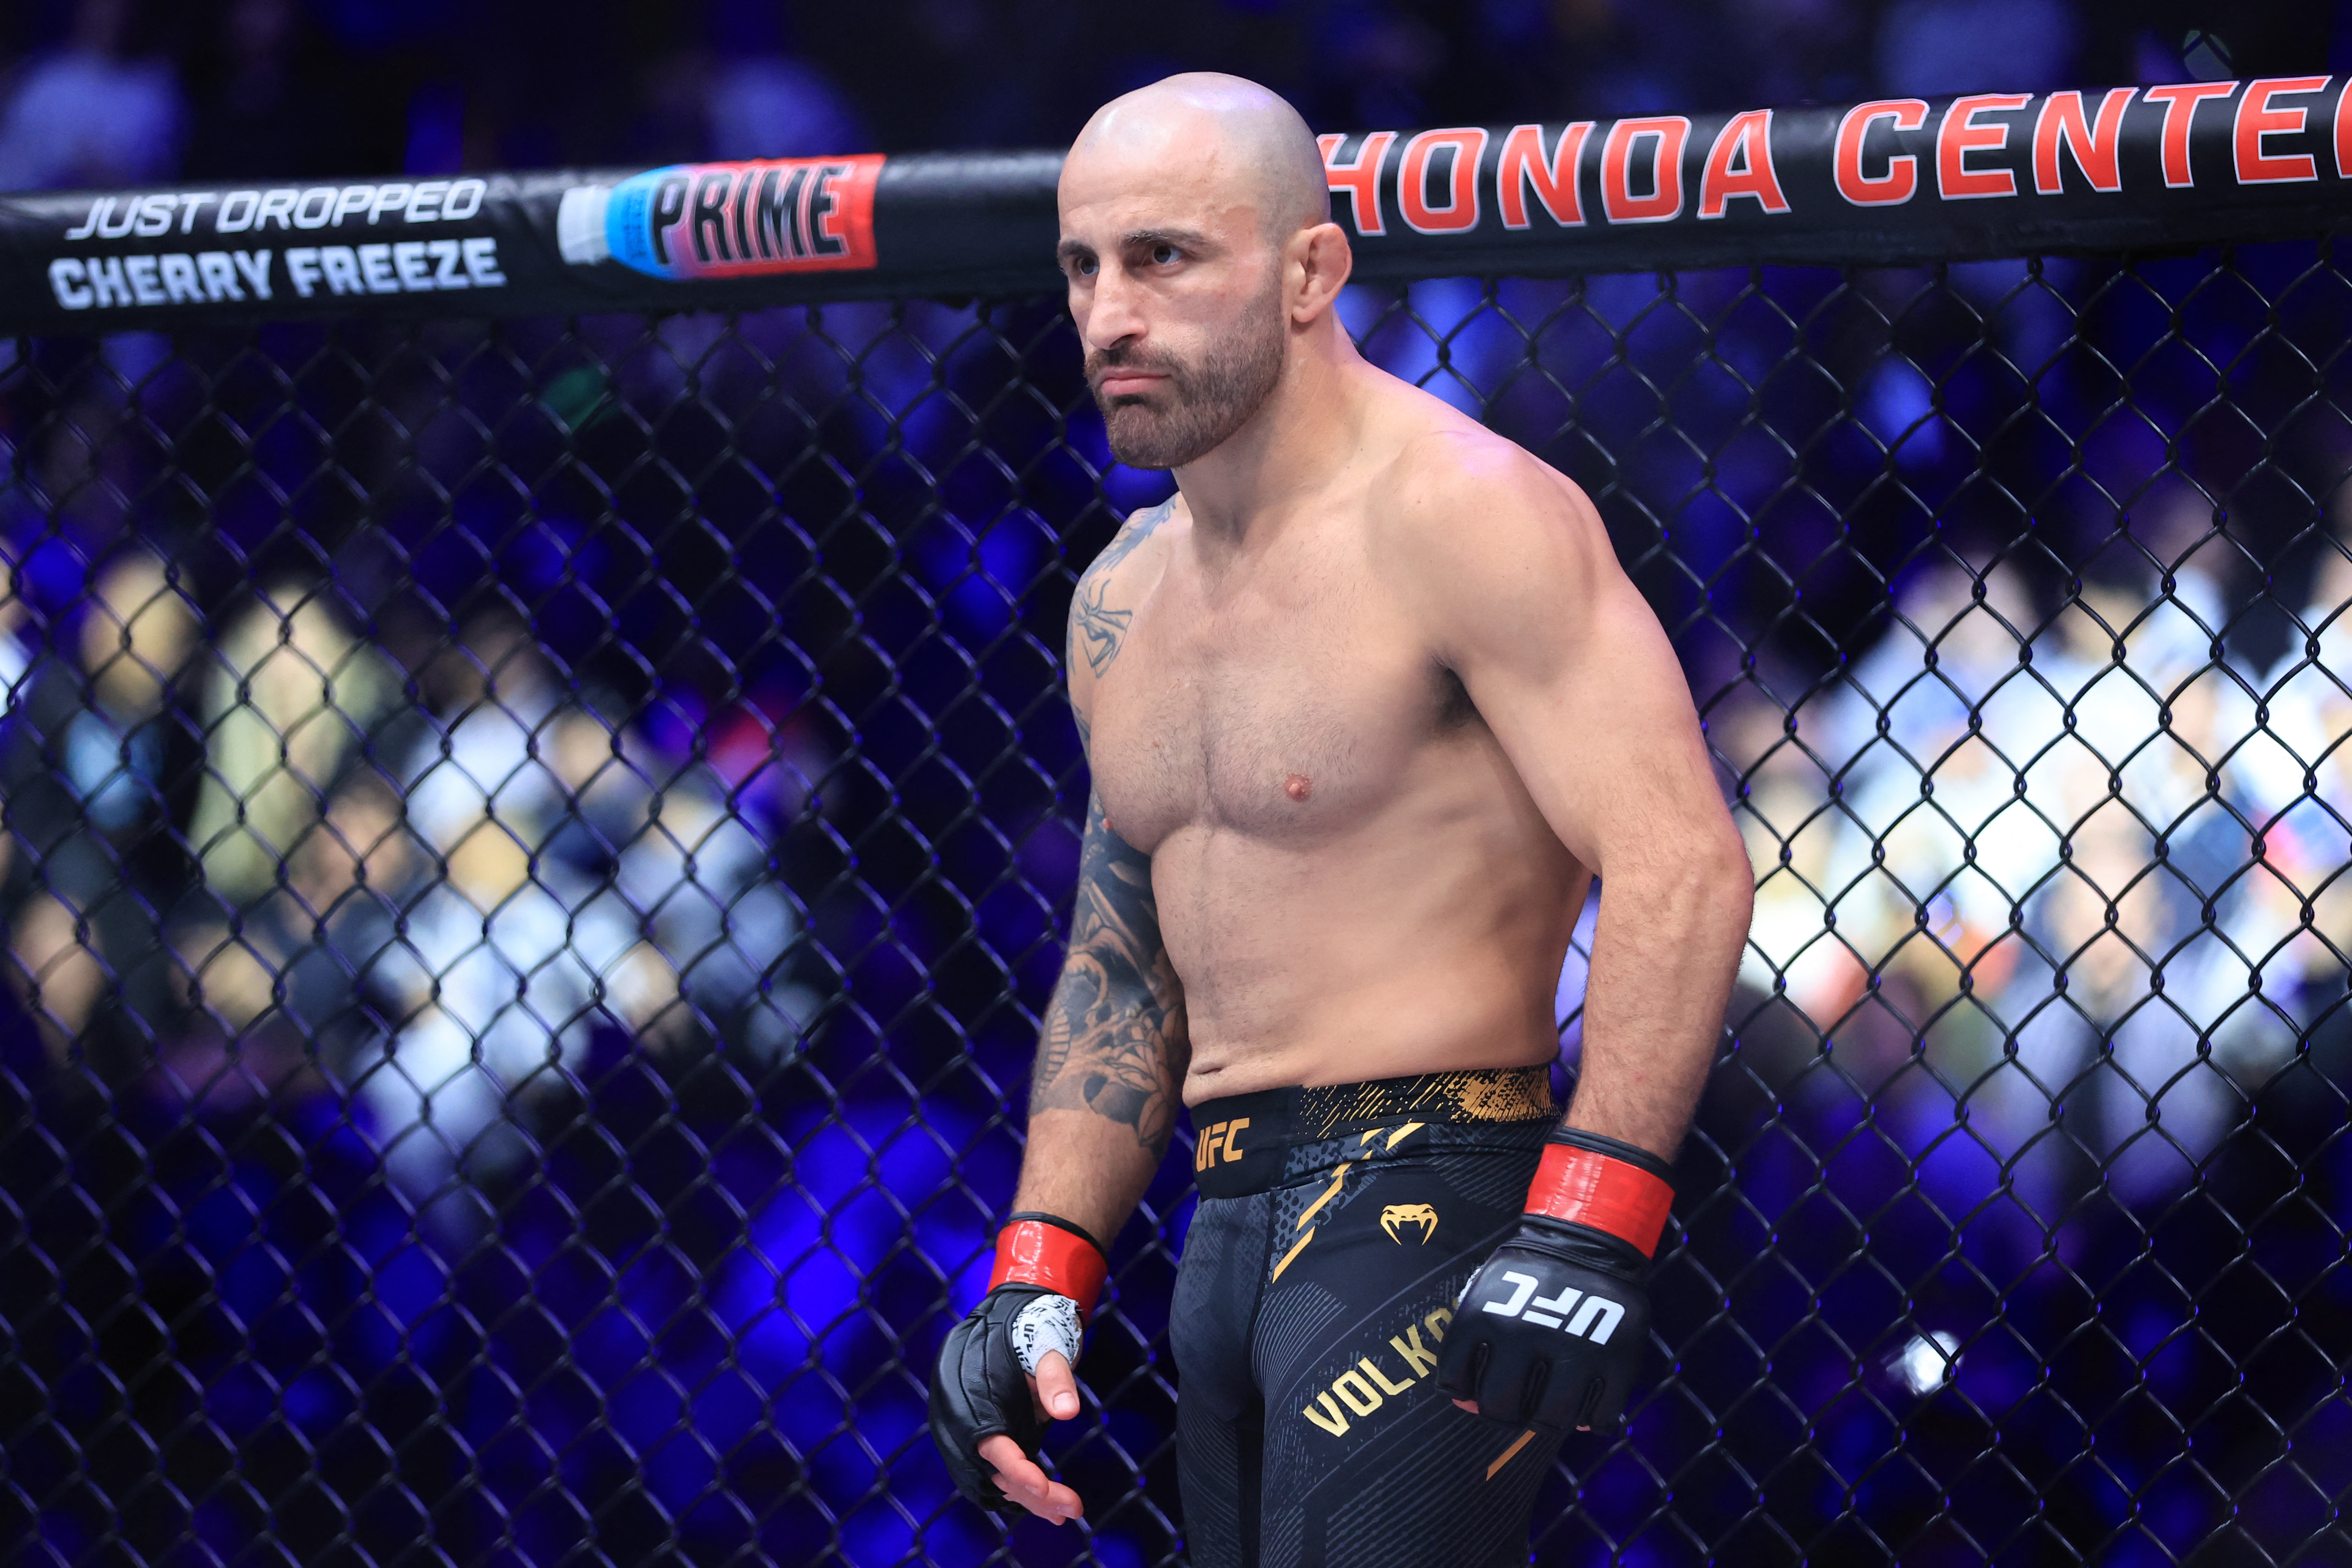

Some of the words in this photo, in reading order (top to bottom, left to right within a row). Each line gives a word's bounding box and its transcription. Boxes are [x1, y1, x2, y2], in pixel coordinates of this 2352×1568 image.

[1317, 109, 1791, 236] HONDA
[1834, 75, 2352, 207] CENTE
[65, 193, 218, 241] JUST
[215, 179, 488, 234] DROPPED
[651, 161, 856, 267] PRIME
[47, 249, 273, 310] CHERRY
[285, 237, 508, 298] FREEZE
[1196, 1117, 1250, 1172] UFC
[1482, 1270, 1626, 1345] UFC
